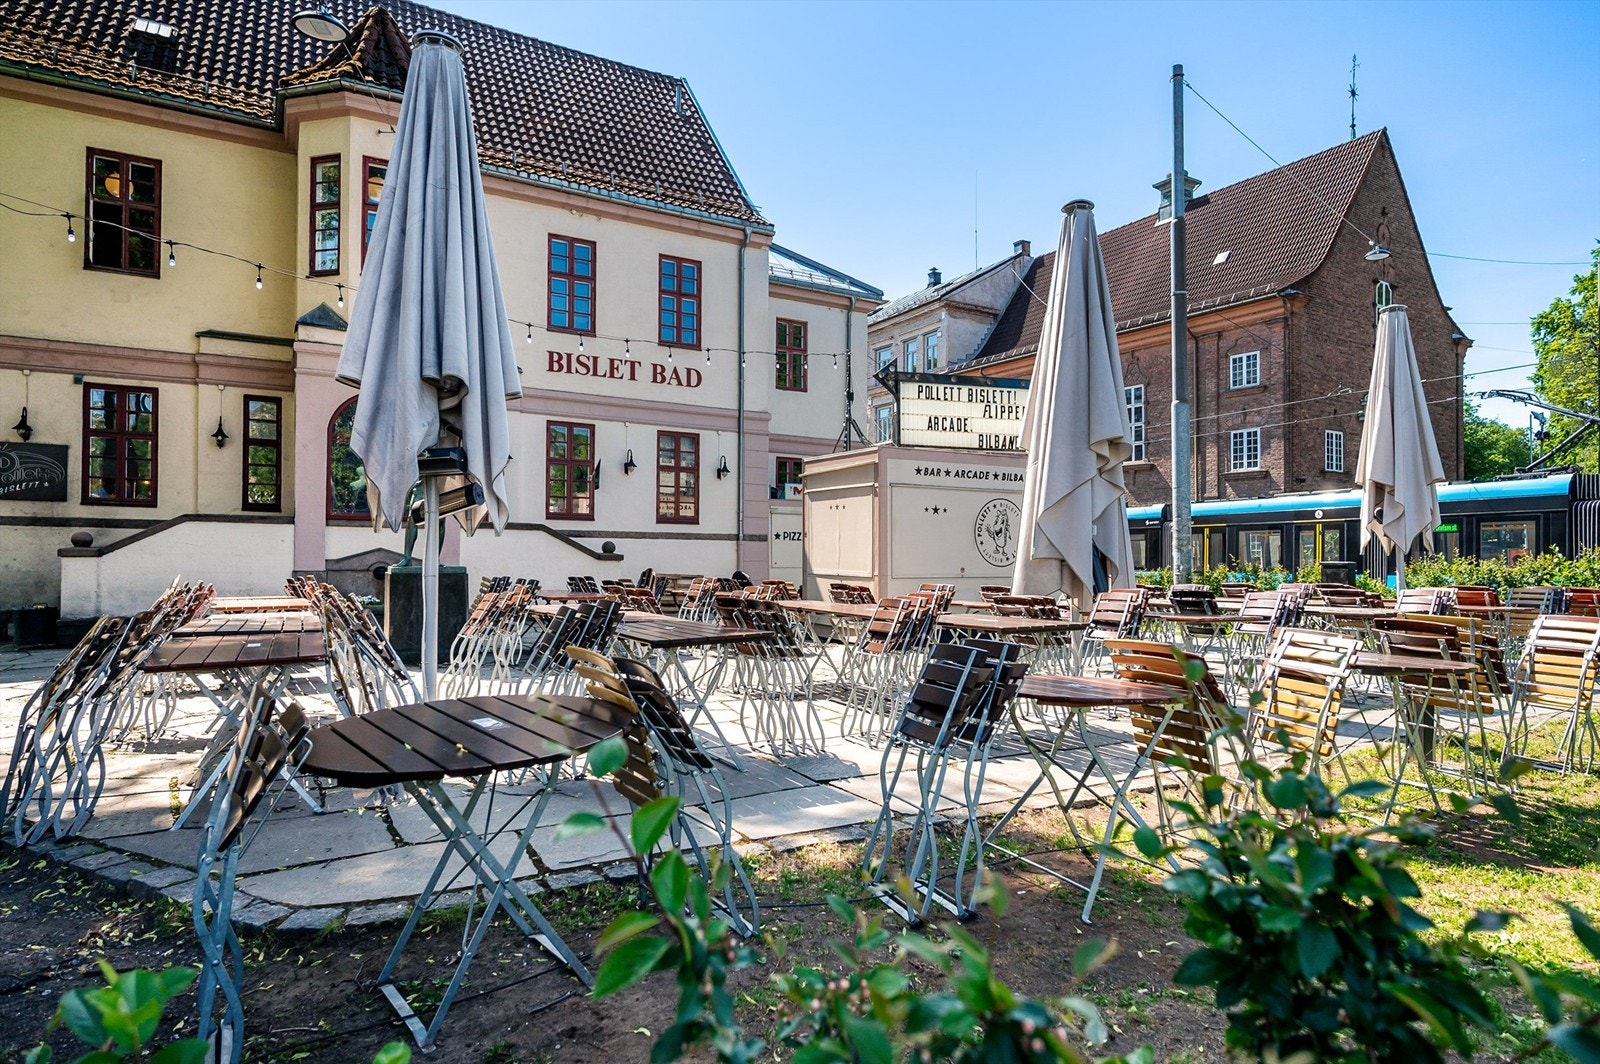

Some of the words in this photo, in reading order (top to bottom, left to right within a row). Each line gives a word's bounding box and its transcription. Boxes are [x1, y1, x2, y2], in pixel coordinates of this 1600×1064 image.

[546, 350, 642, 381] BISLET
[650, 362, 703, 388] BAD
[917, 385, 962, 401] POLLETT
[967, 388, 1017, 404] BISLETT!
[927, 416, 973, 432] ARCADE.
[923, 467, 942, 477] BAR
[953, 469, 990, 480] ARCADE
[977, 506, 991, 537] POLLETT
